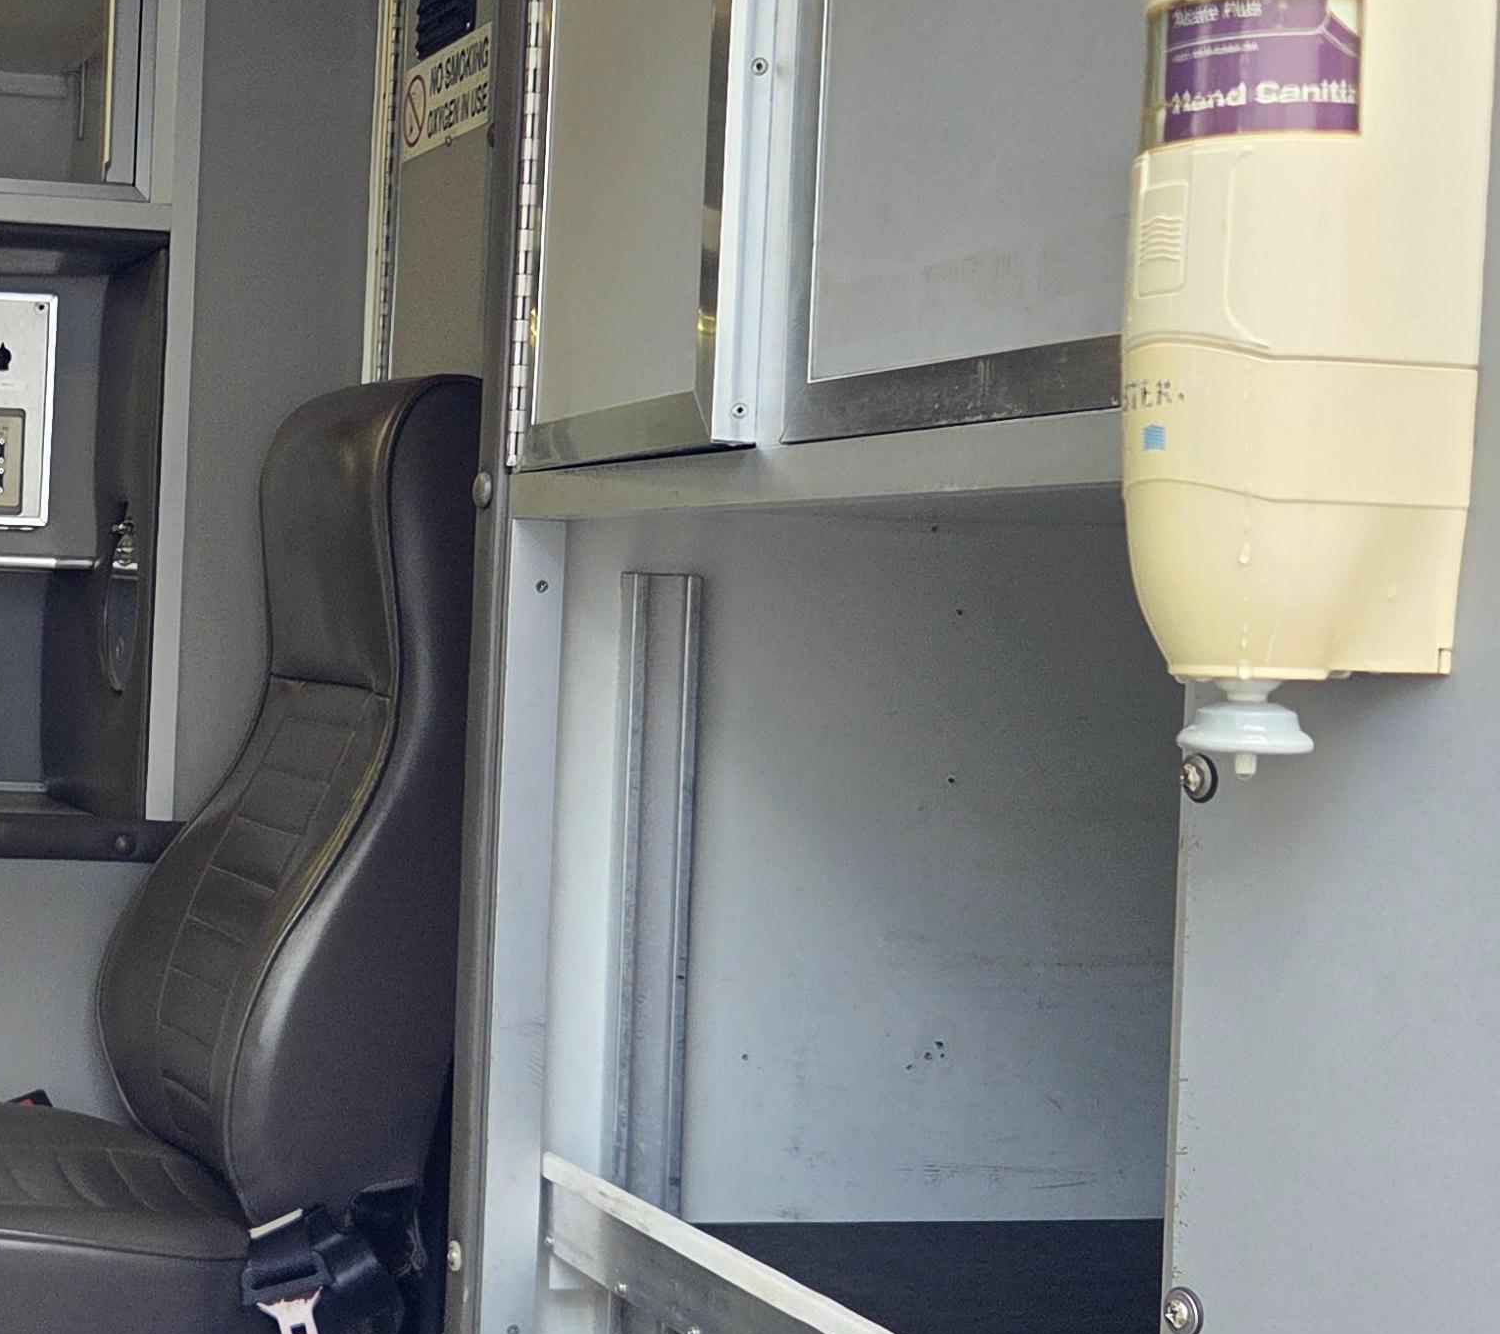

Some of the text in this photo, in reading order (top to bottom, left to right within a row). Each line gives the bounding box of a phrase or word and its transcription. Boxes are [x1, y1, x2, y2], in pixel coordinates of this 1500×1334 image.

[429, 35, 489, 97] NO SMOKING
[427, 97, 459, 139] OXYGEN
[470, 80, 488, 118] USE
[1172, 81, 1247, 115] Hand
